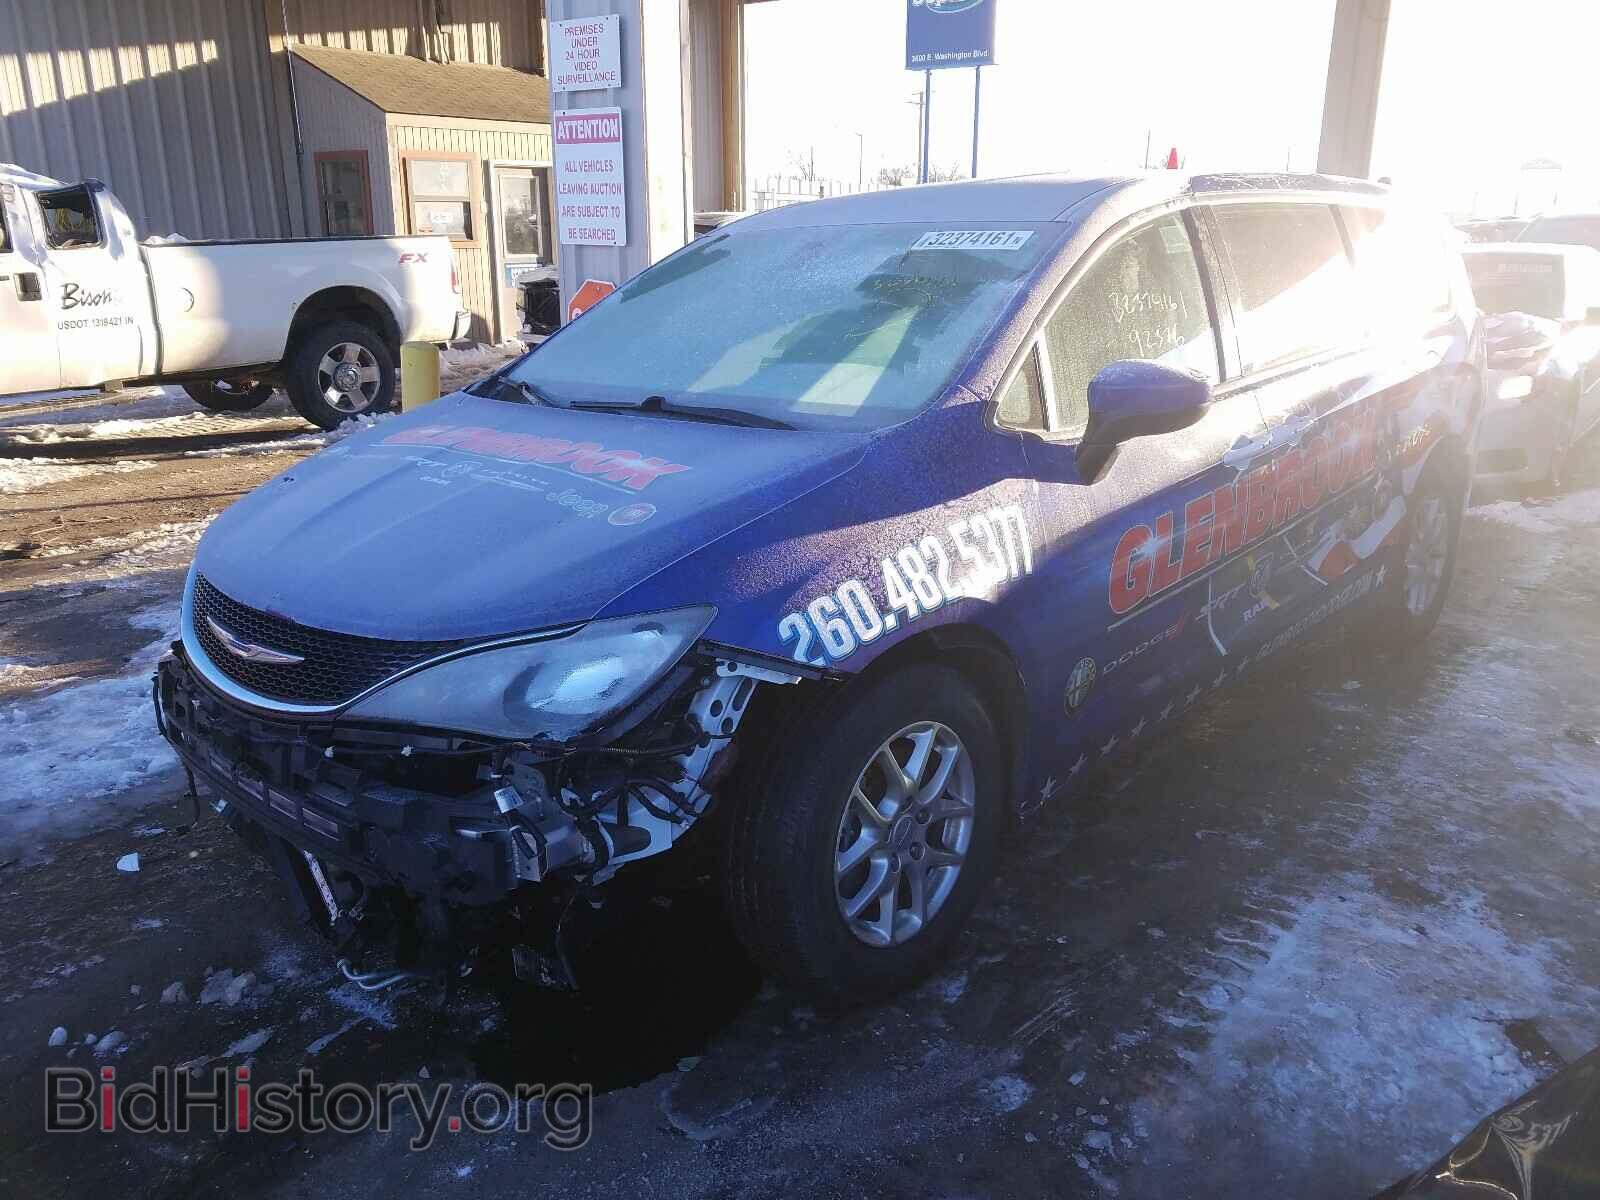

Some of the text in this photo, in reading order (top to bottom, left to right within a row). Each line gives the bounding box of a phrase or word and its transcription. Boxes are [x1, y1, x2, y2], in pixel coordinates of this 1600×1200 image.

[564, 23, 604, 37] PREMISES
[571, 36, 598, 49] UNDER
[565, 48, 601, 60] 24 HOUR
[573, 60, 598, 72] VIDEO
[557, 71, 616, 85] SURVEILLANCE
[557, 118, 619, 140] ATTENTION
[564, 159, 614, 173] ALL VEHICLES
[559, 183, 622, 195] LEAVING AUCTION
[561, 205, 620, 218] ARE SUBJECT TO
[568, 228, 616, 241] BE SEARCHED
[60, 282, 113, 310] Bison
[57, 319, 88, 330] USDOT
